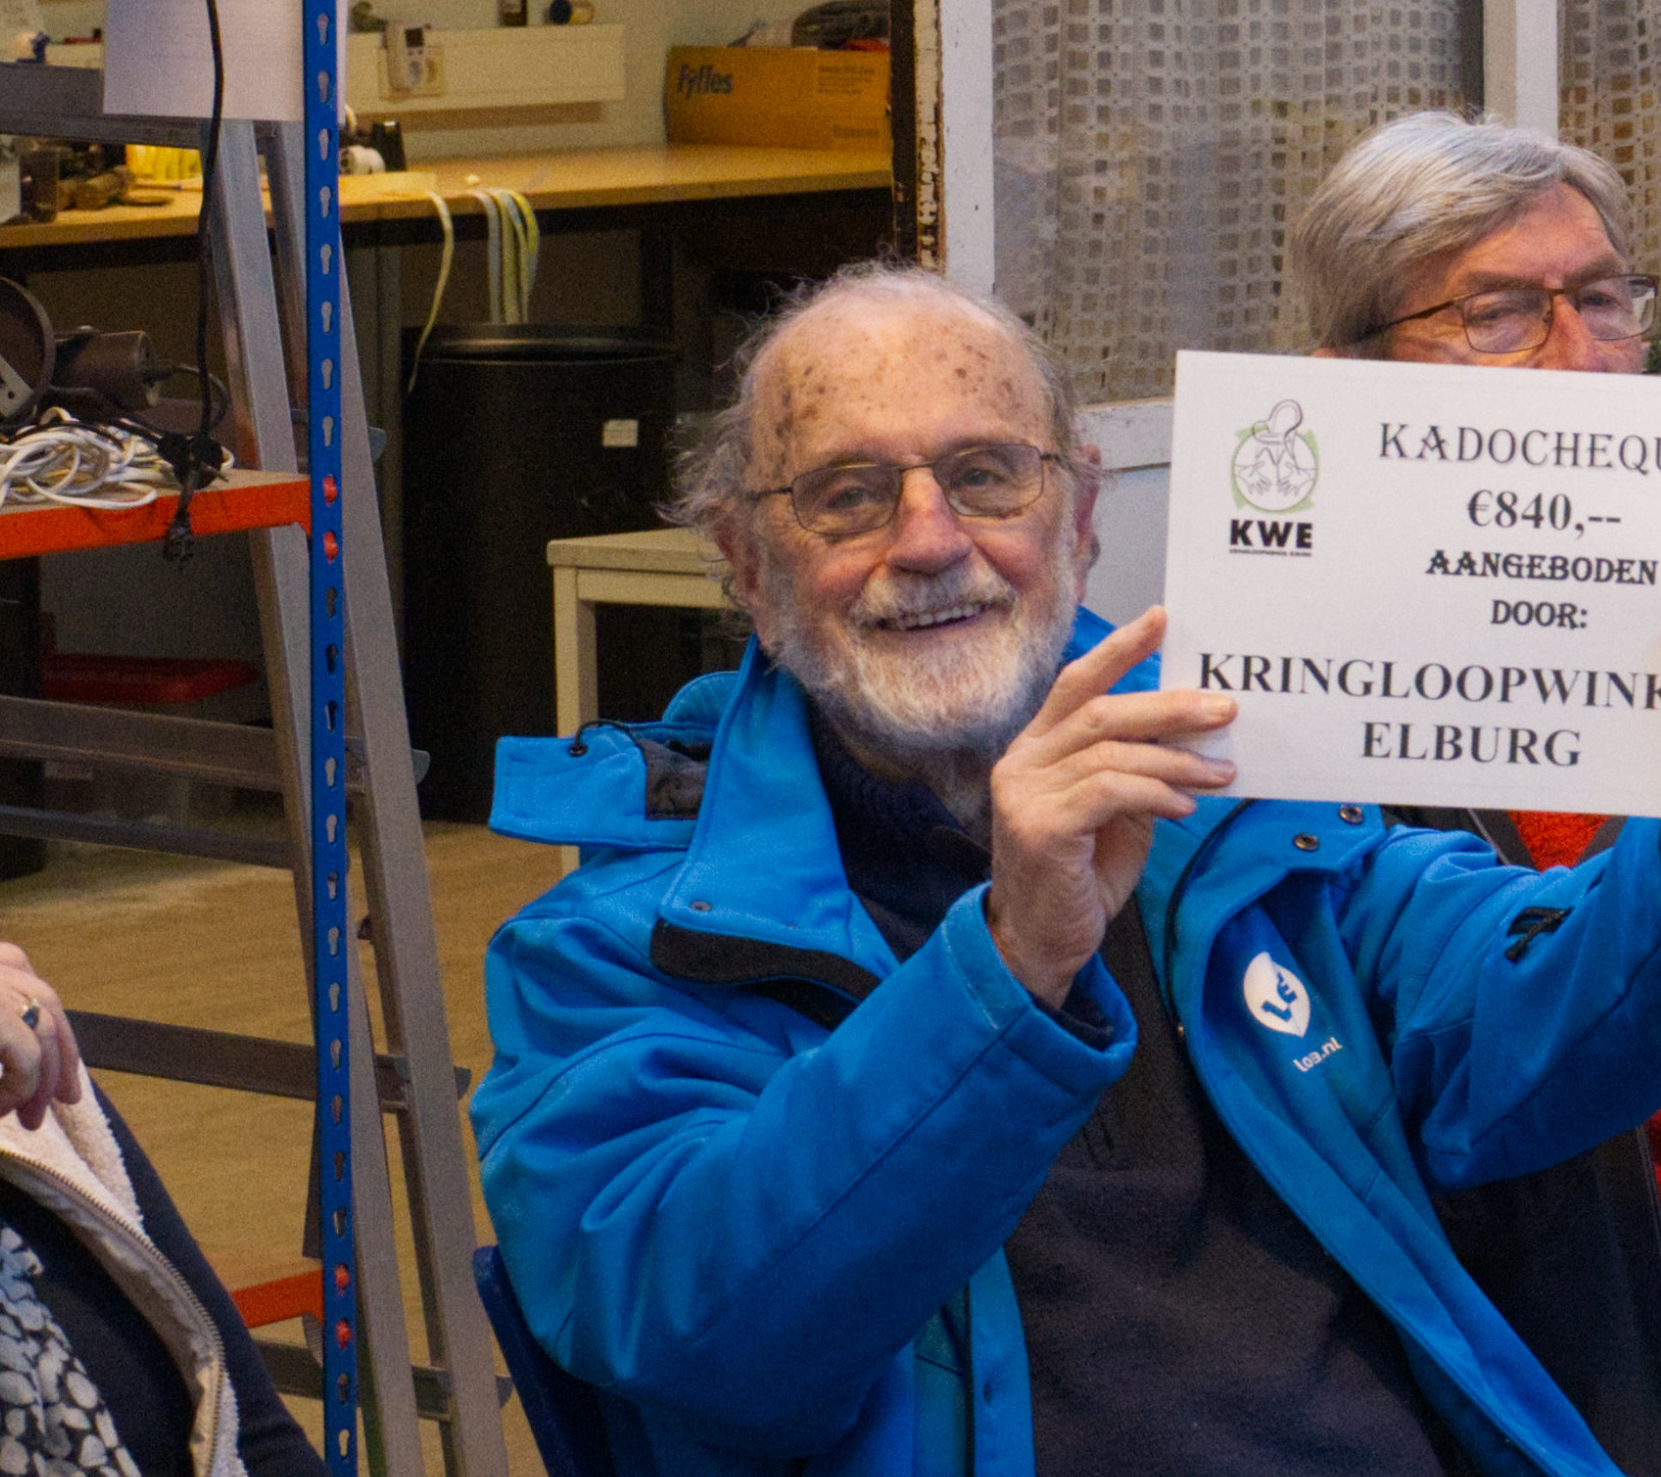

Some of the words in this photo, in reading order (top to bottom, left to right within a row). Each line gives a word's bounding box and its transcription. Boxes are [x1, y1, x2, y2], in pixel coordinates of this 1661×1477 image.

[1465, 489, 1622, 539] €840,--
[1228, 519, 1314, 550] KWE
[1424, 548, 1659, 586] AANGEBODEN
[1490, 597, 1589, 629] DOOR:
[1361, 720, 1583, 769] ELBURG
